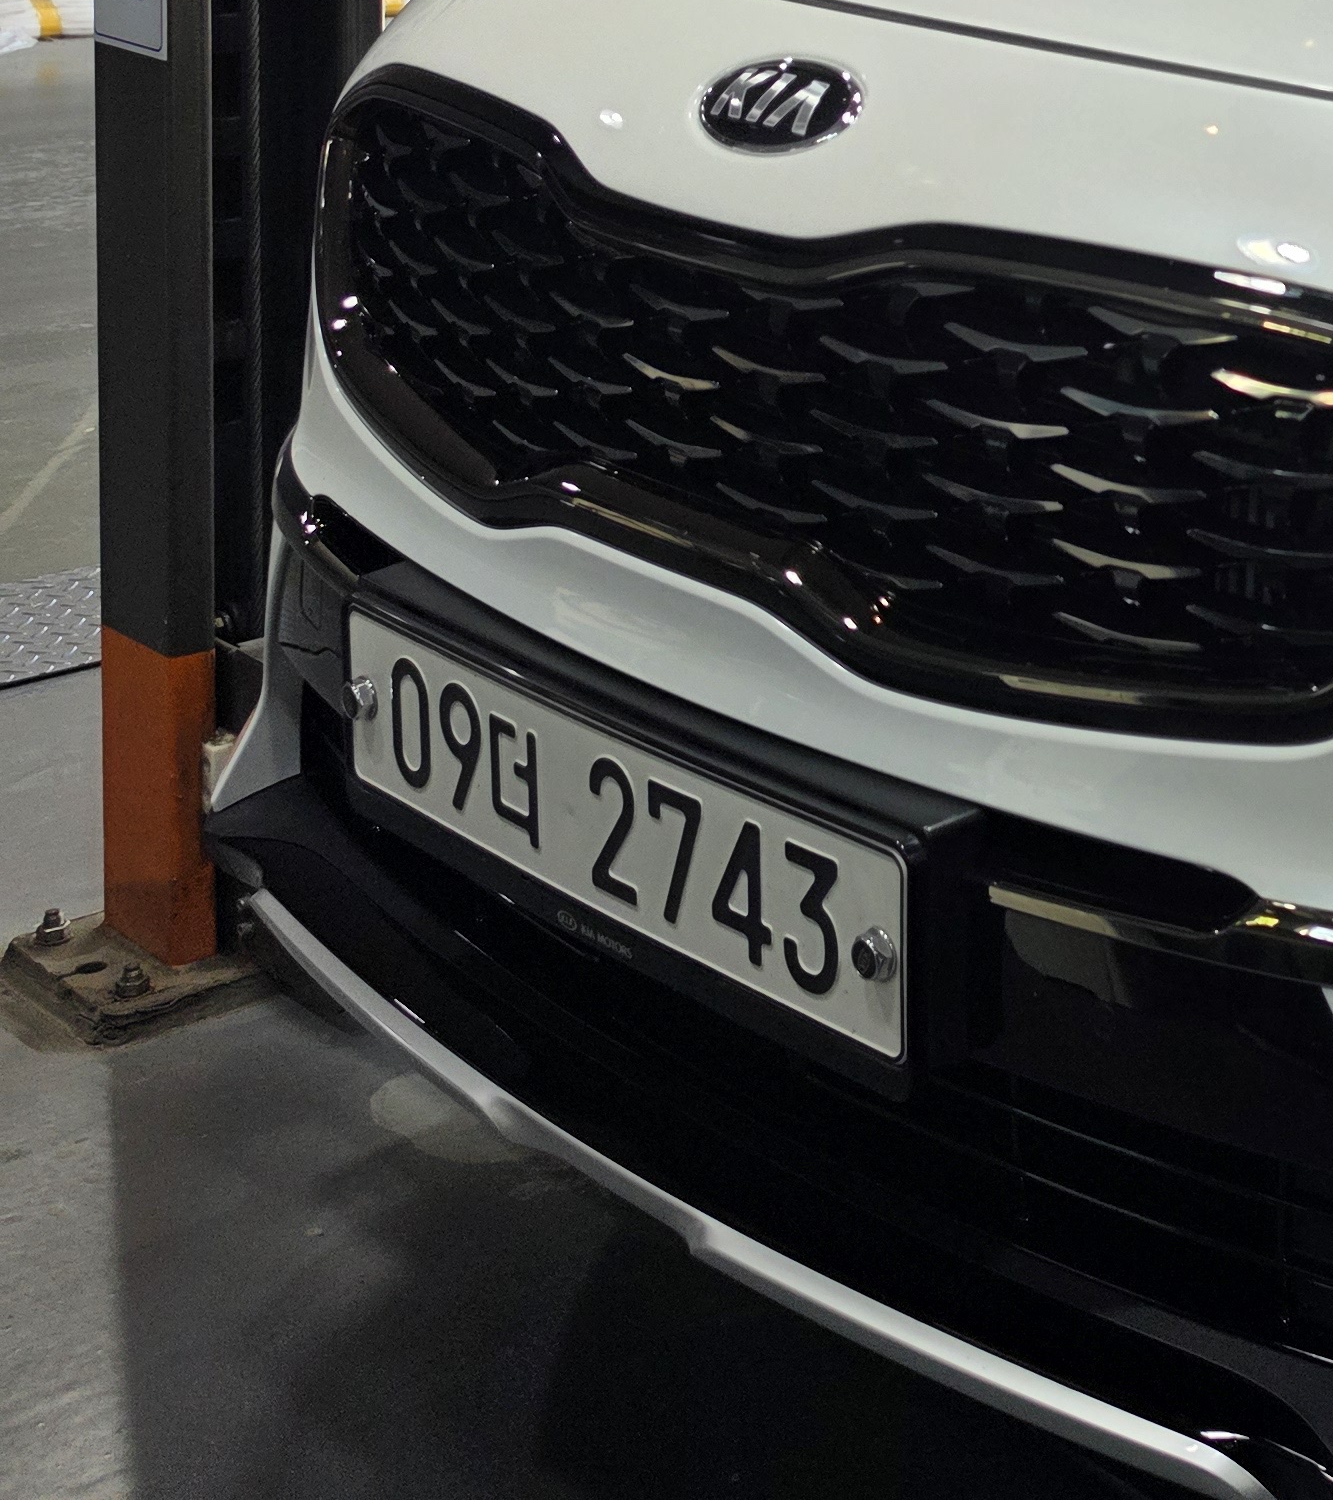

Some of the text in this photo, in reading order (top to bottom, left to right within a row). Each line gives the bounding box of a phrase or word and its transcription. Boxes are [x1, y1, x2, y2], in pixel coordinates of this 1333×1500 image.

[709, 67, 831, 137] KIA
[391, 657, 838, 995] 09더 2743
